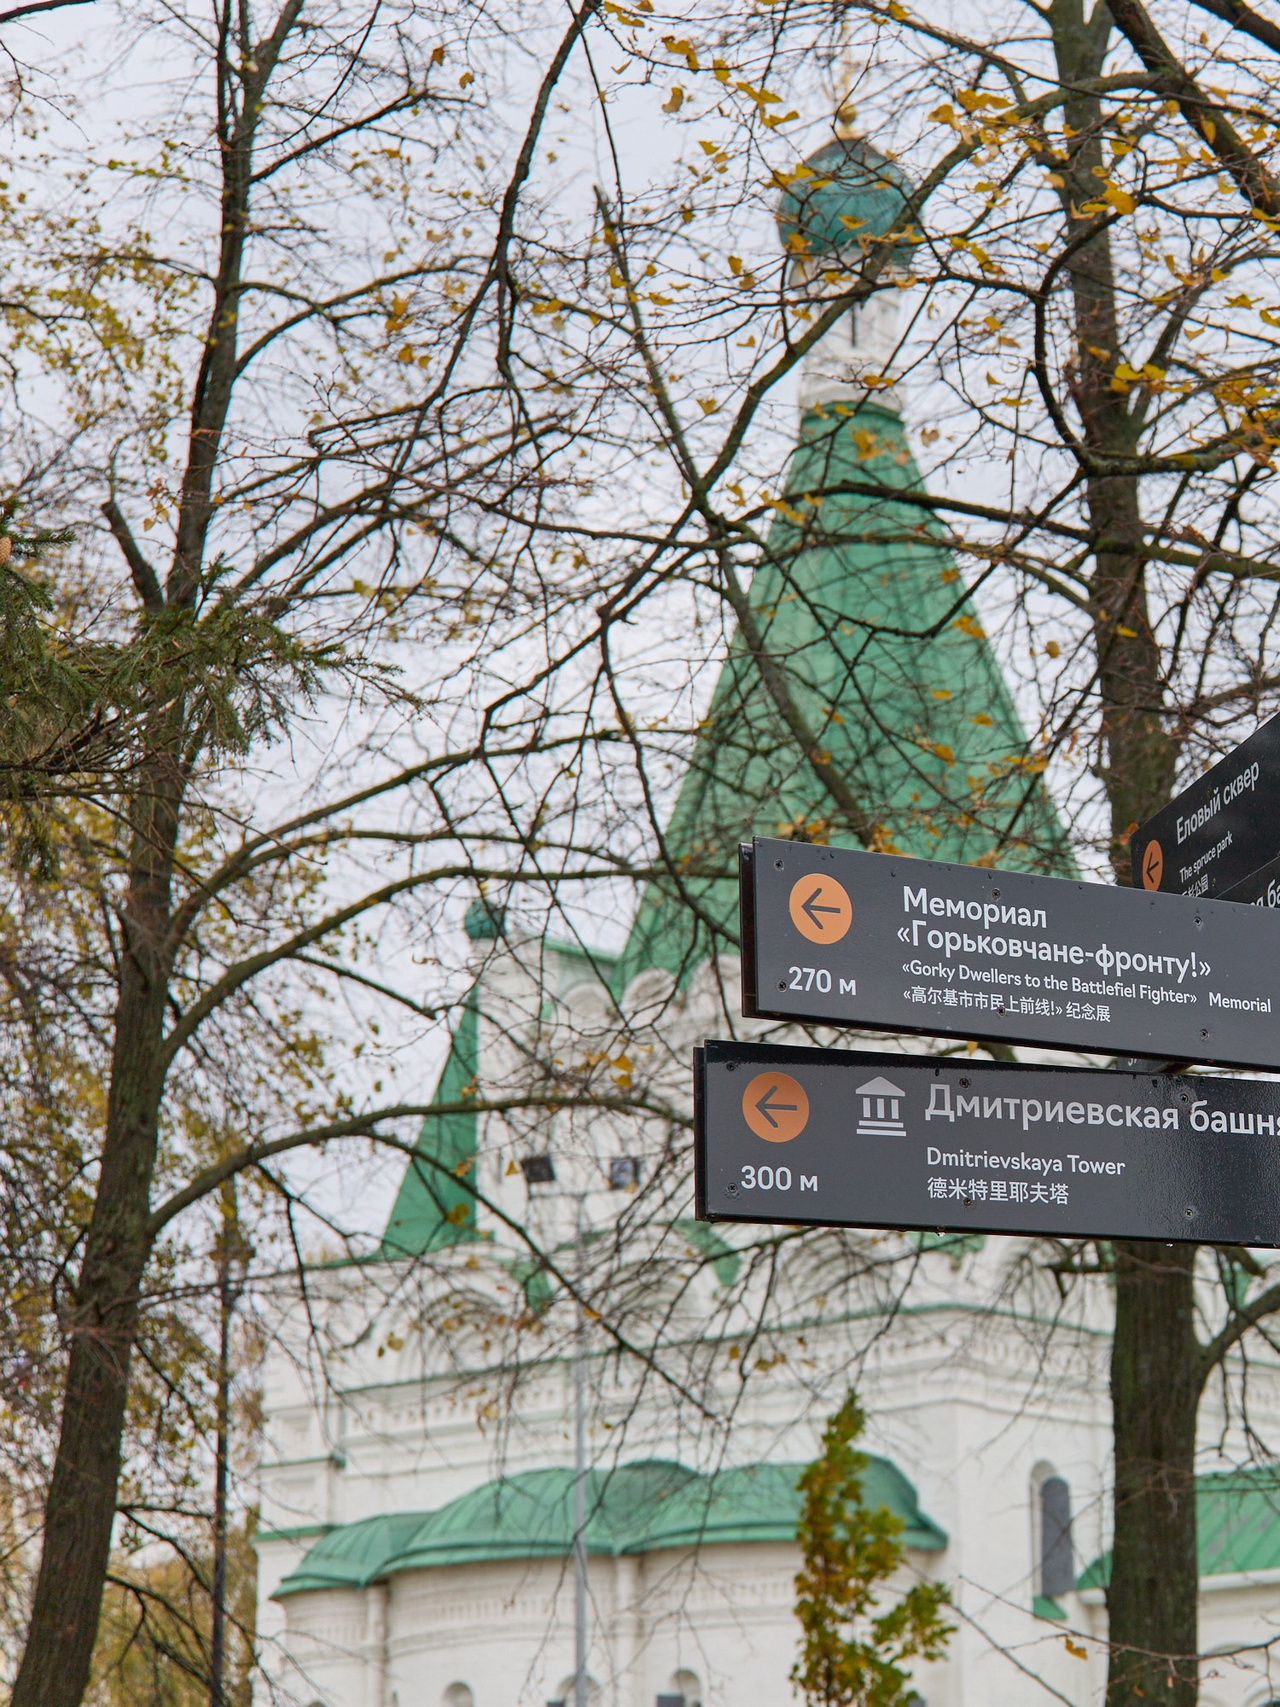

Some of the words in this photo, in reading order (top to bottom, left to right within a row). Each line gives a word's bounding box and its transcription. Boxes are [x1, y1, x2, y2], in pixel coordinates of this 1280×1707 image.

[1177, 787, 1220, 844] Еловый
[1224, 762, 1258, 804] сквер
[1180, 867, 1192, 882] The
[1194, 848, 1215, 874] spruce
[1217, 831, 1232, 858] park
[904, 886, 1046, 929] Мемориал
[898, 920, 1210, 983] «Горьковчане-фронту!»
[789, 967, 831, 992] 270
[840, 979, 856, 995] м
[903, 960, 955, 982] «Gorky
[959, 965, 1021, 985] Dwellers
[1025, 974, 1040, 987] to
[1044, 975, 1068, 990] the
[1072, 977, 1135, 998] Battlefiel
[1140, 985, 1197, 1004] Fighter»
[1209, 992, 1271, 1012] Memorial
[1066, 1001, 1110, 1022] 纪念展
[925, 1084, 1178, 1130] Дмитриевская
[742, 1166, 791, 1190] 300
[801, 1176, 817, 1191] м
[928, 1147, 1062, 1176] Dmitrievskaya
[1067, 1155, 1125, 1174] Tower
[928, 1177, 1068, 1204] 德米特里耶夫塔
